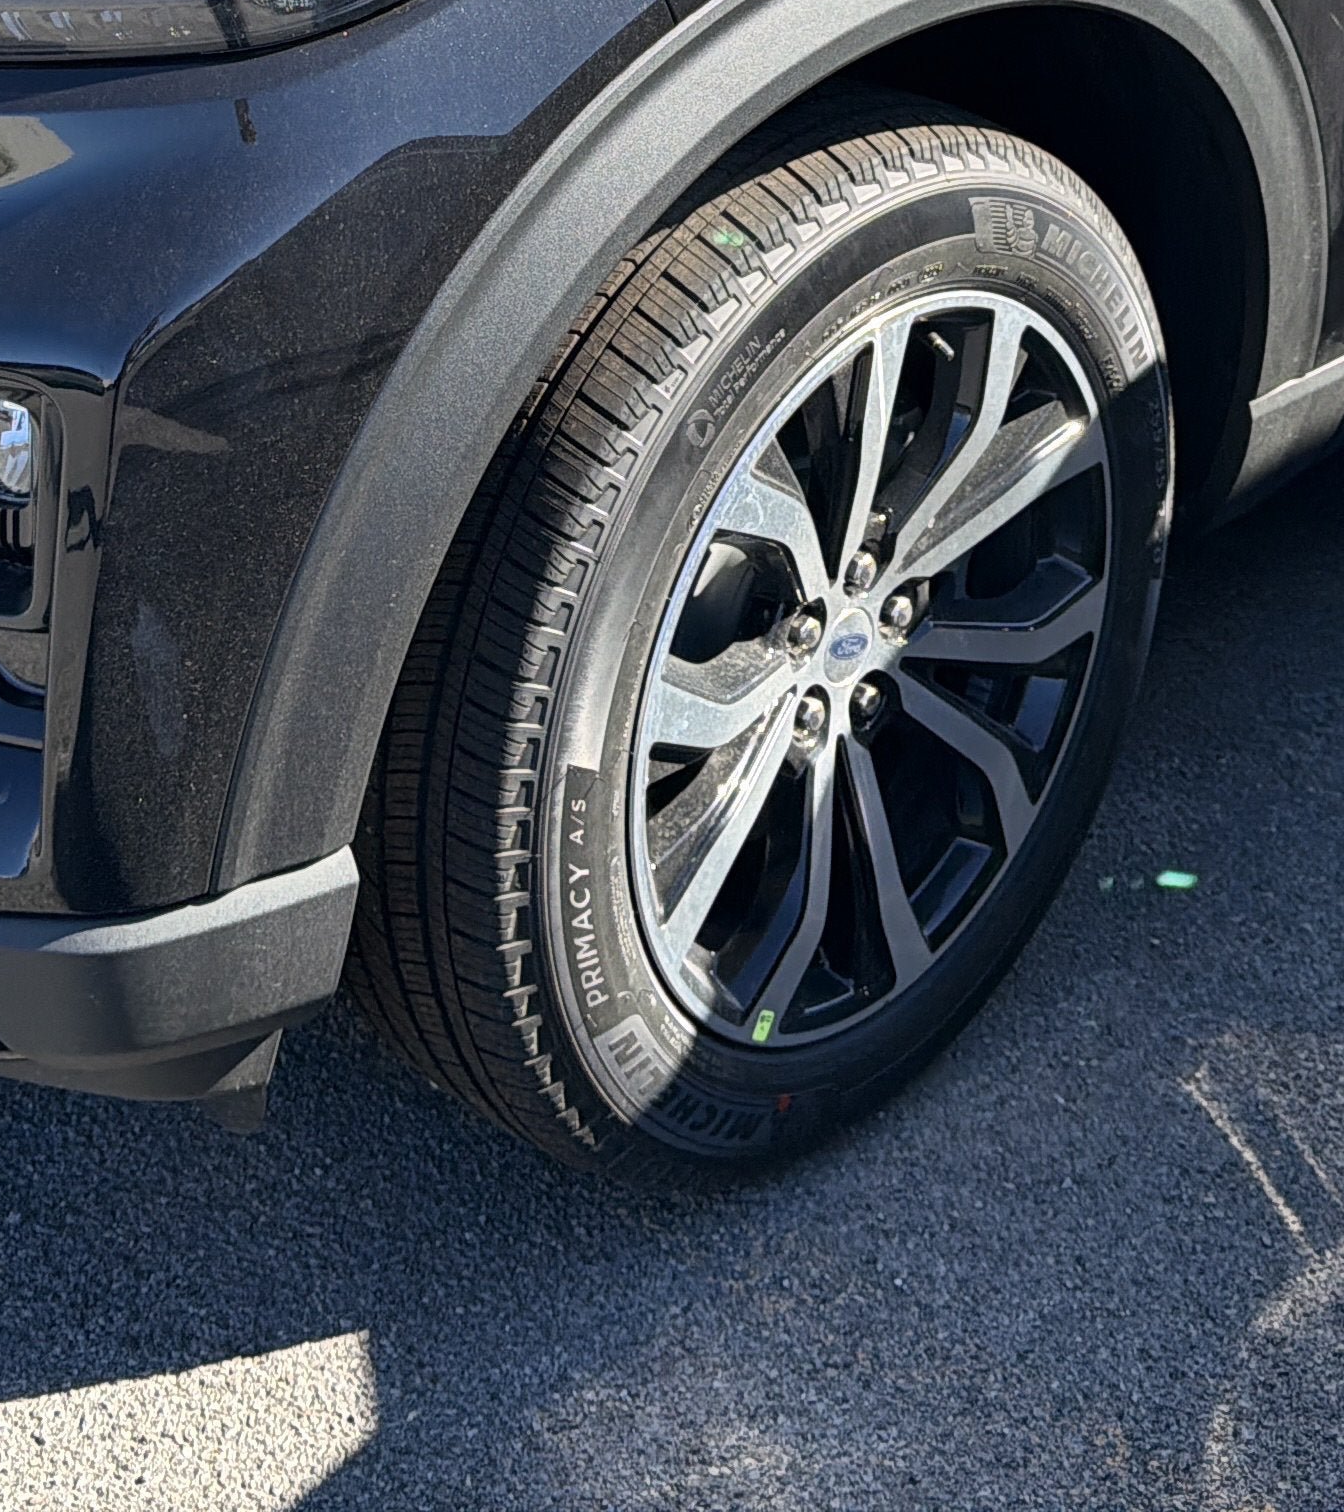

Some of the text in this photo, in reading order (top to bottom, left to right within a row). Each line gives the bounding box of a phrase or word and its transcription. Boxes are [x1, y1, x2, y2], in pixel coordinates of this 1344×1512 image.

[708, 336, 762, 408] MICHELIN
[1040, 223, 1151, 374] MICHELIN
[568, 798, 611, 1009] PRIMACY A/S
